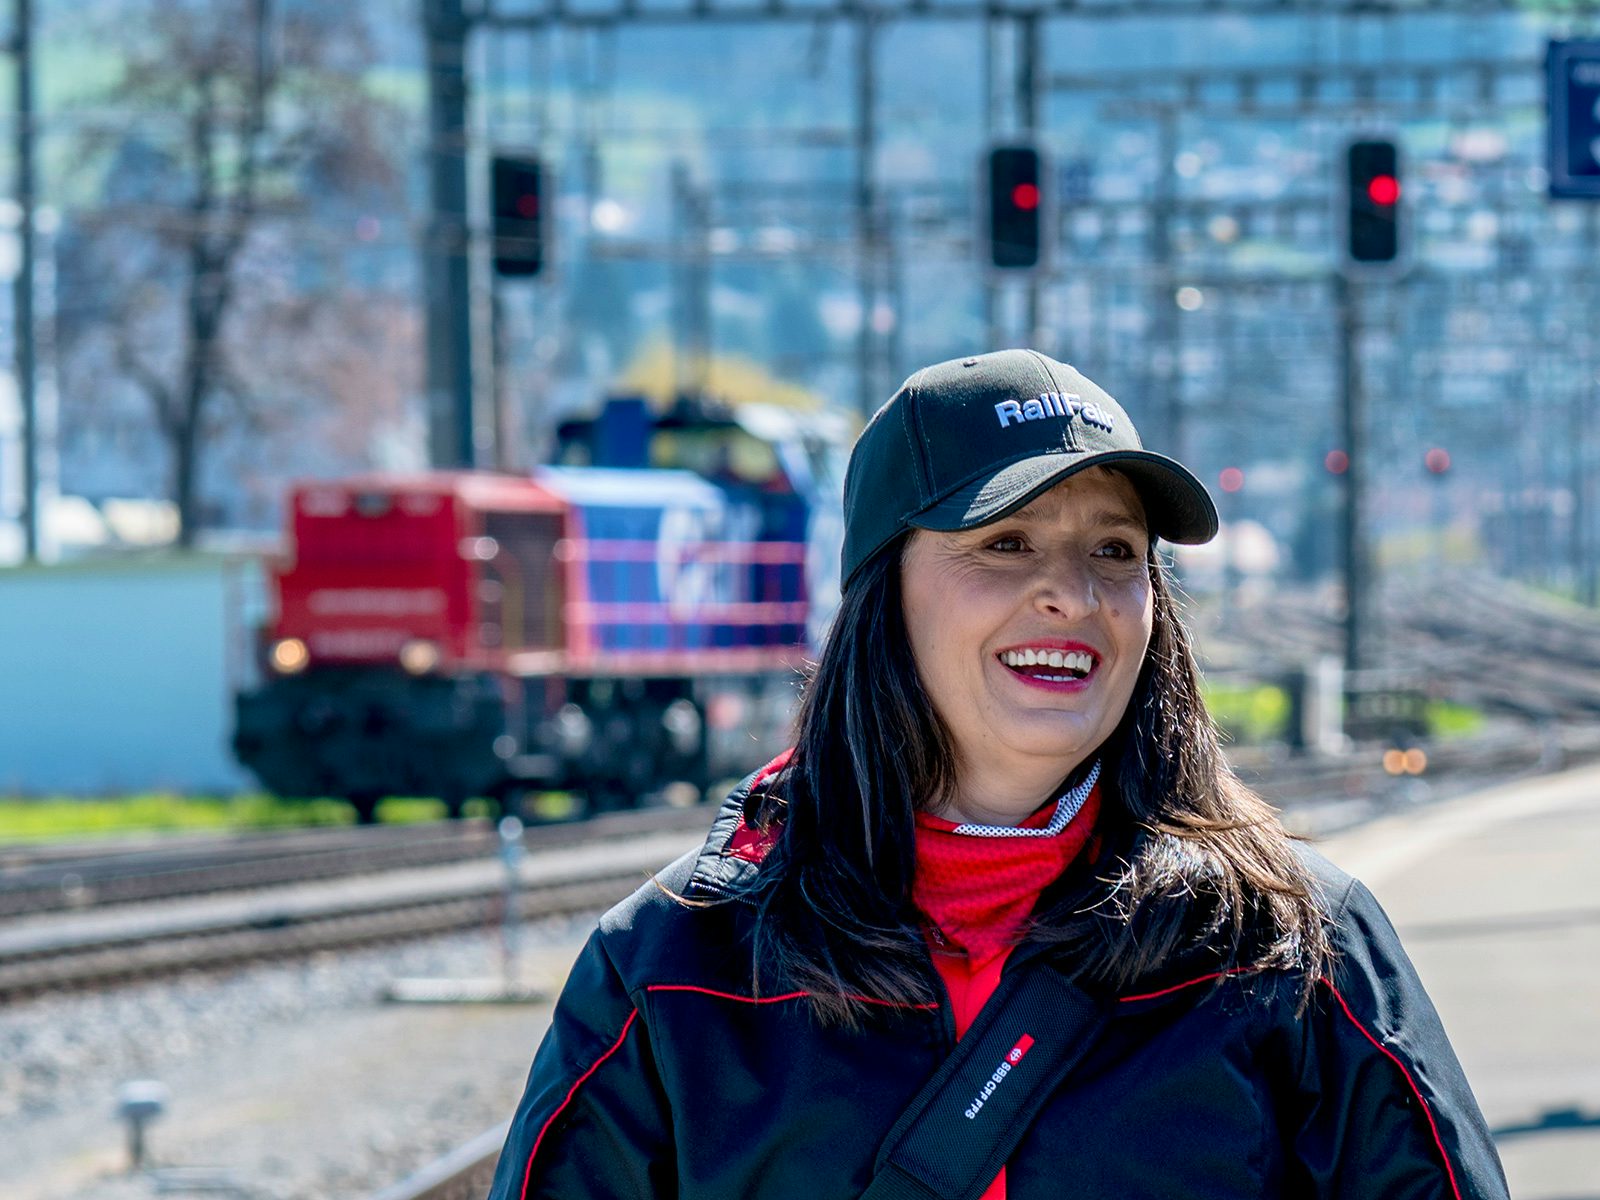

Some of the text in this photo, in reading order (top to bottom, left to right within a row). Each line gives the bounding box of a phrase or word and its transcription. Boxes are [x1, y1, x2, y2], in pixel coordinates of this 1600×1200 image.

[994, 391, 1115, 429] RailFair
[965, 1062, 1012, 1119] SBB CFF FFS
